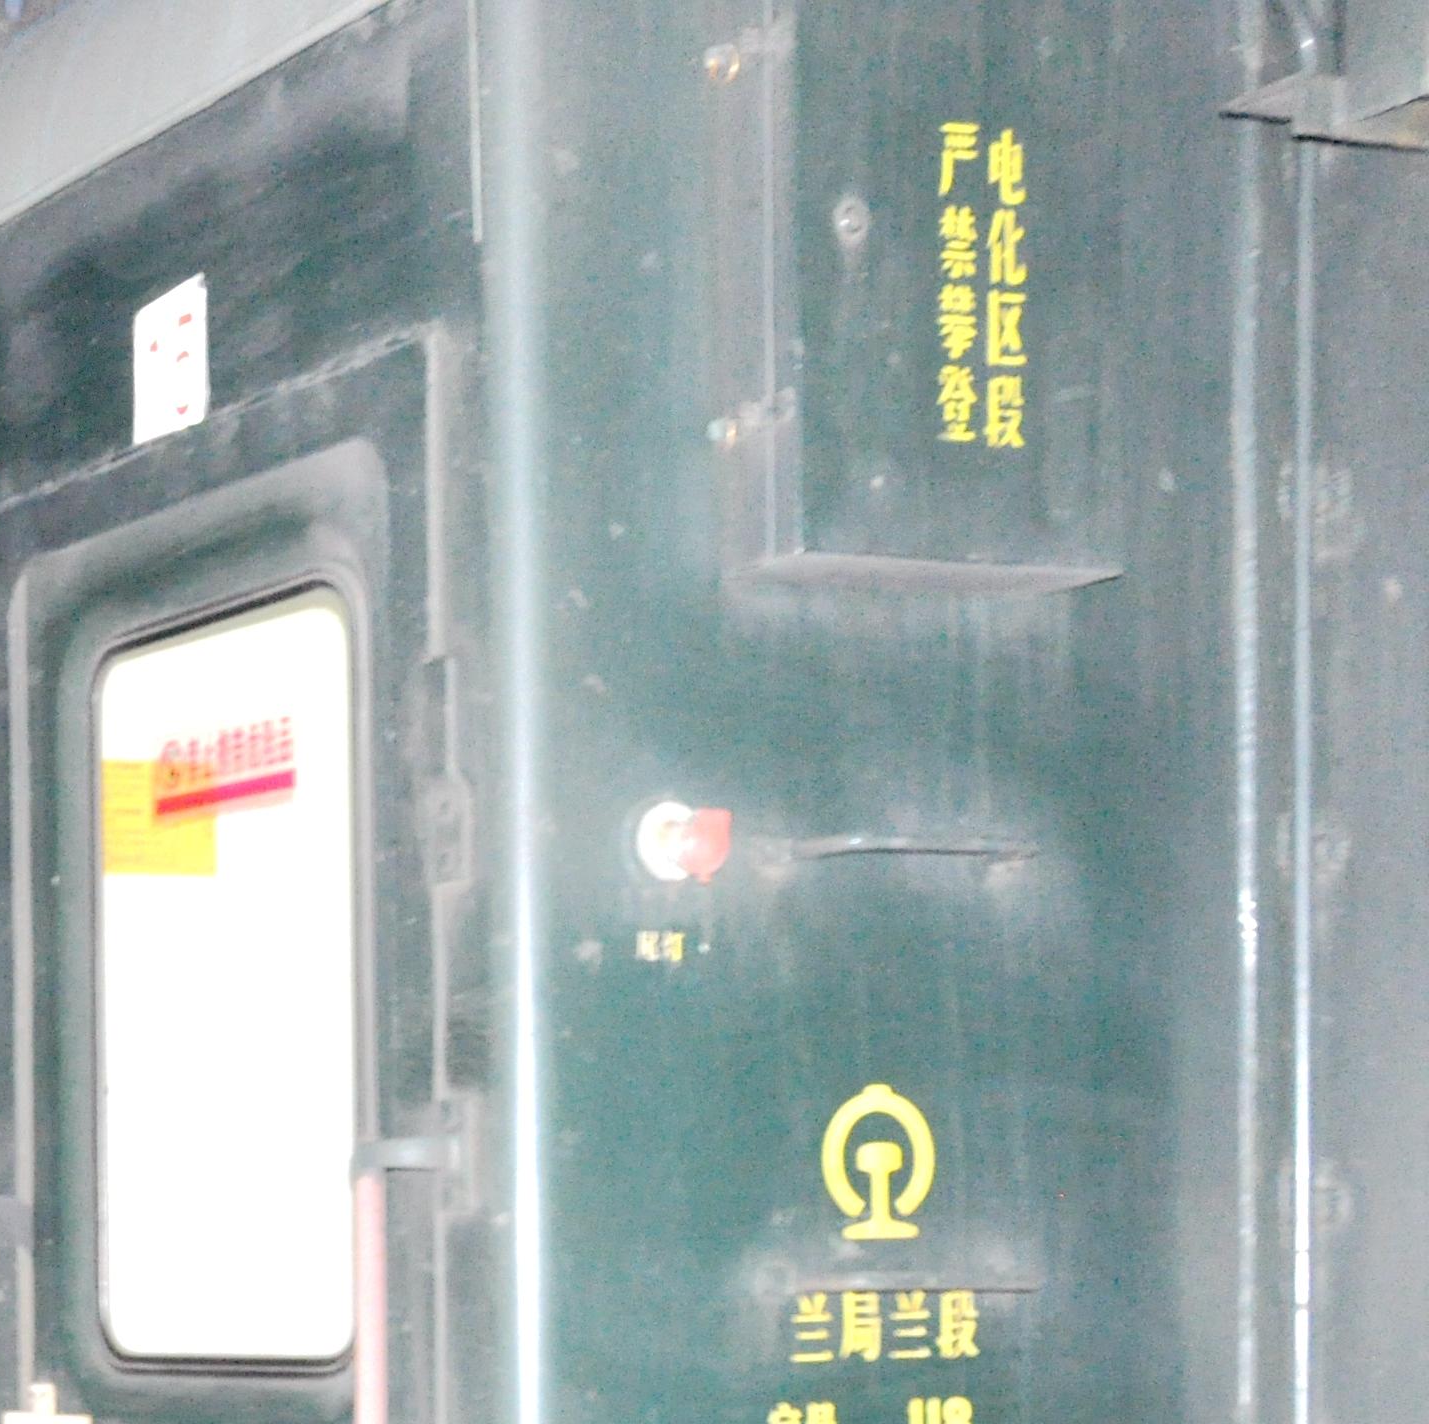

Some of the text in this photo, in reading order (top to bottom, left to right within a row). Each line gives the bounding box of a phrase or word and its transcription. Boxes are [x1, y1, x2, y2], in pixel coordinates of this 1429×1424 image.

[937, 121, 979, 442] 严禁攀登
[985, 129, 1027, 448] 电化区段
[791, 1289, 980, 1363] 兰局兰段
